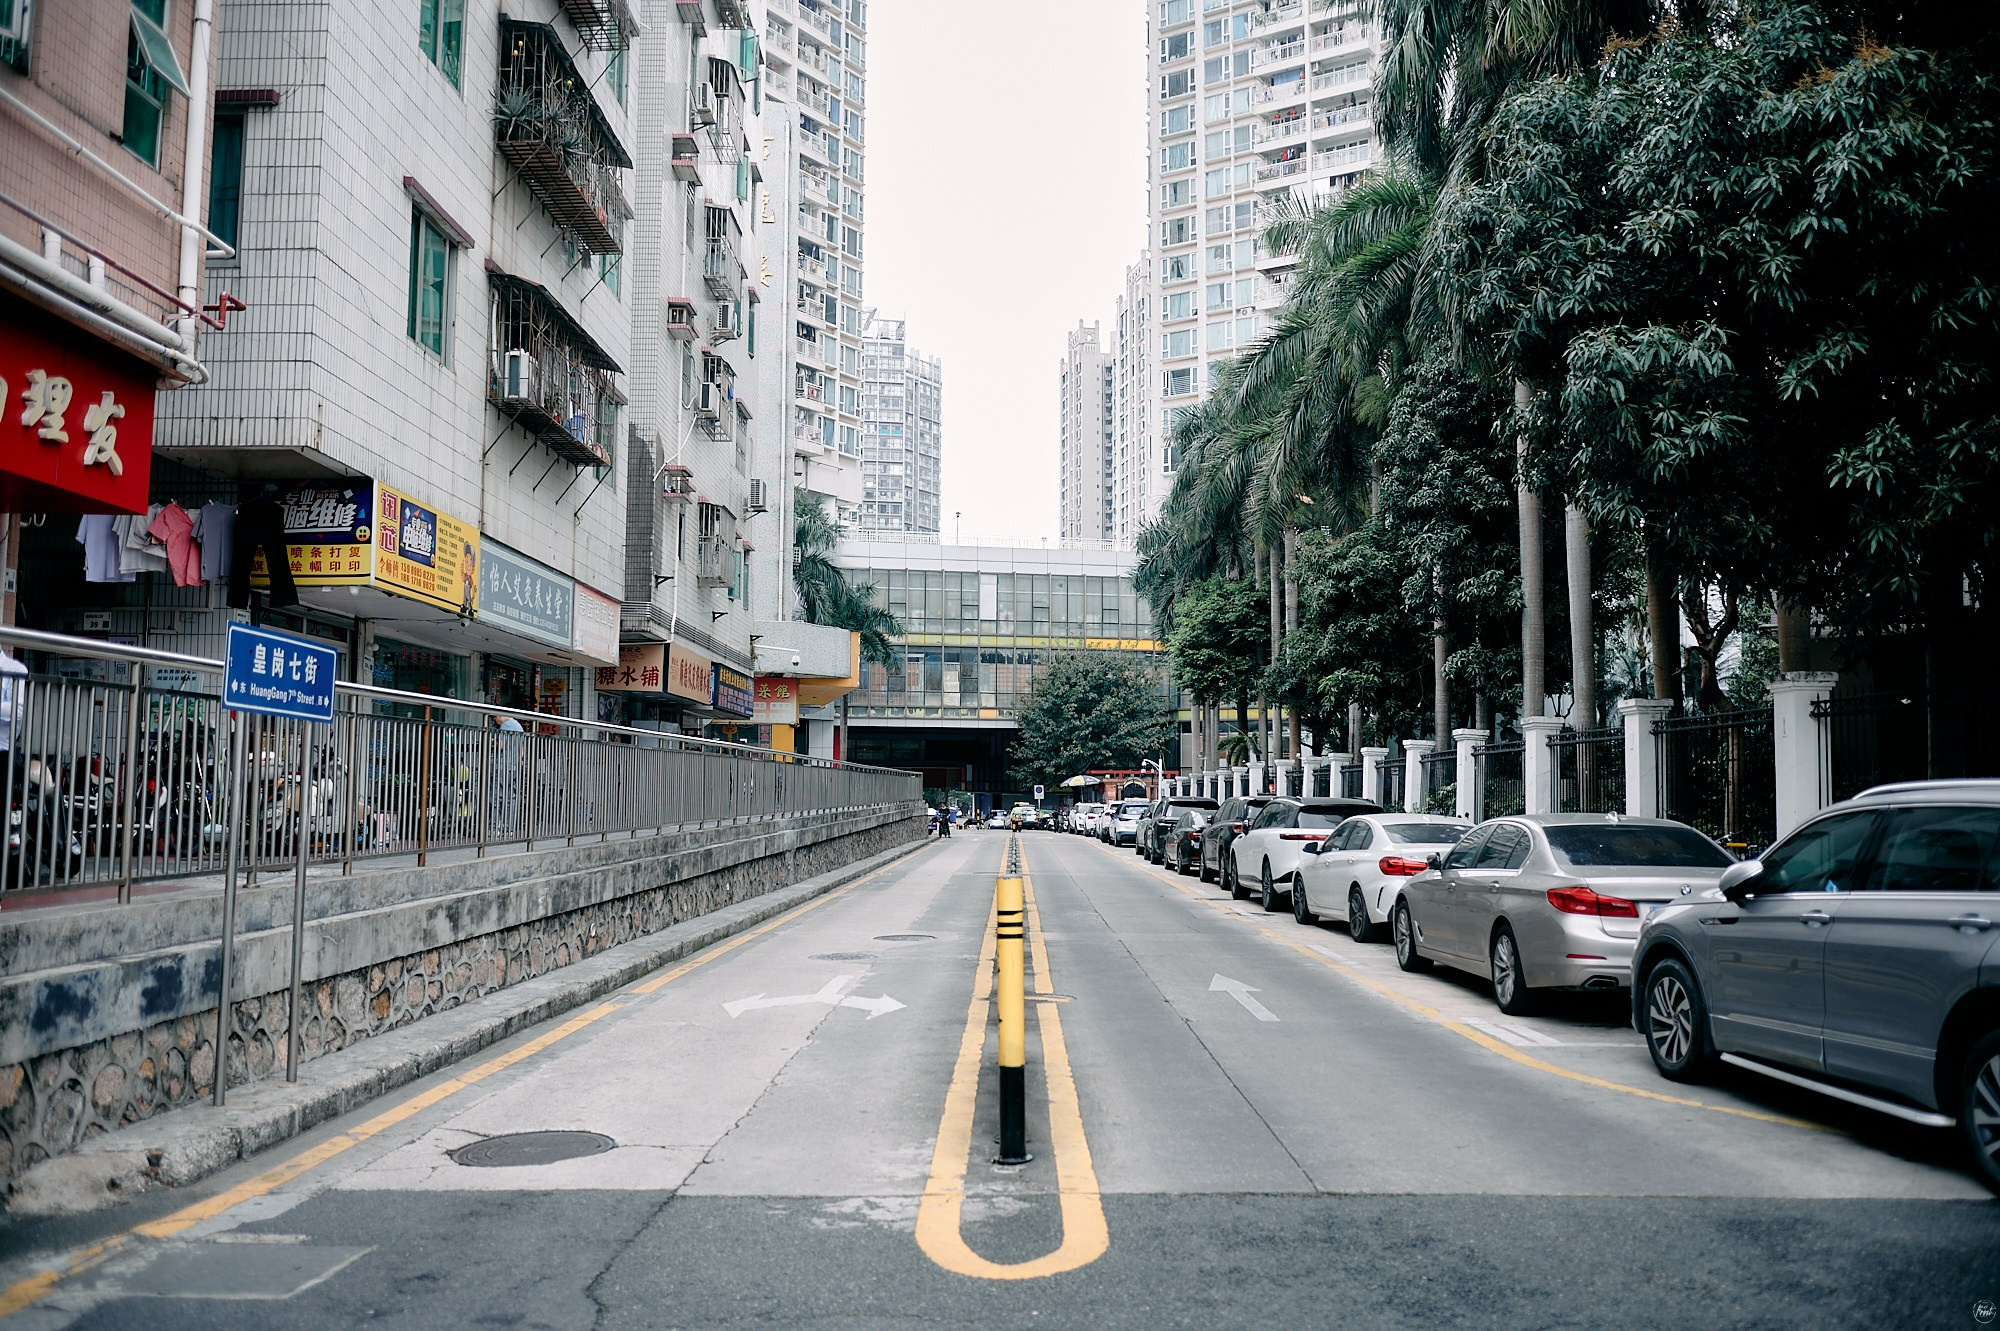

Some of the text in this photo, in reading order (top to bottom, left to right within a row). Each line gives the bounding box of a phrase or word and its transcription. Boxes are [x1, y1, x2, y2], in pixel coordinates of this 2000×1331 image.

[0, 369, 125, 475] 理发
[285, 489, 315, 505] 专业
[281, 499, 358, 529] 脑维修
[380, 488, 398, 554] 讯芯
[401, 562, 410, 573] 159
[489, 561, 563, 620] 怡人艾灸养生堂
[89, 620, 99, 628] 39
[252, 643, 318, 685] 皇岗七街
[596, 665, 660, 687] 糖水铺
[240, 682, 323, 706] 东 HuangGang 7th Street 西
[757, 683, 791, 699] 菜館
